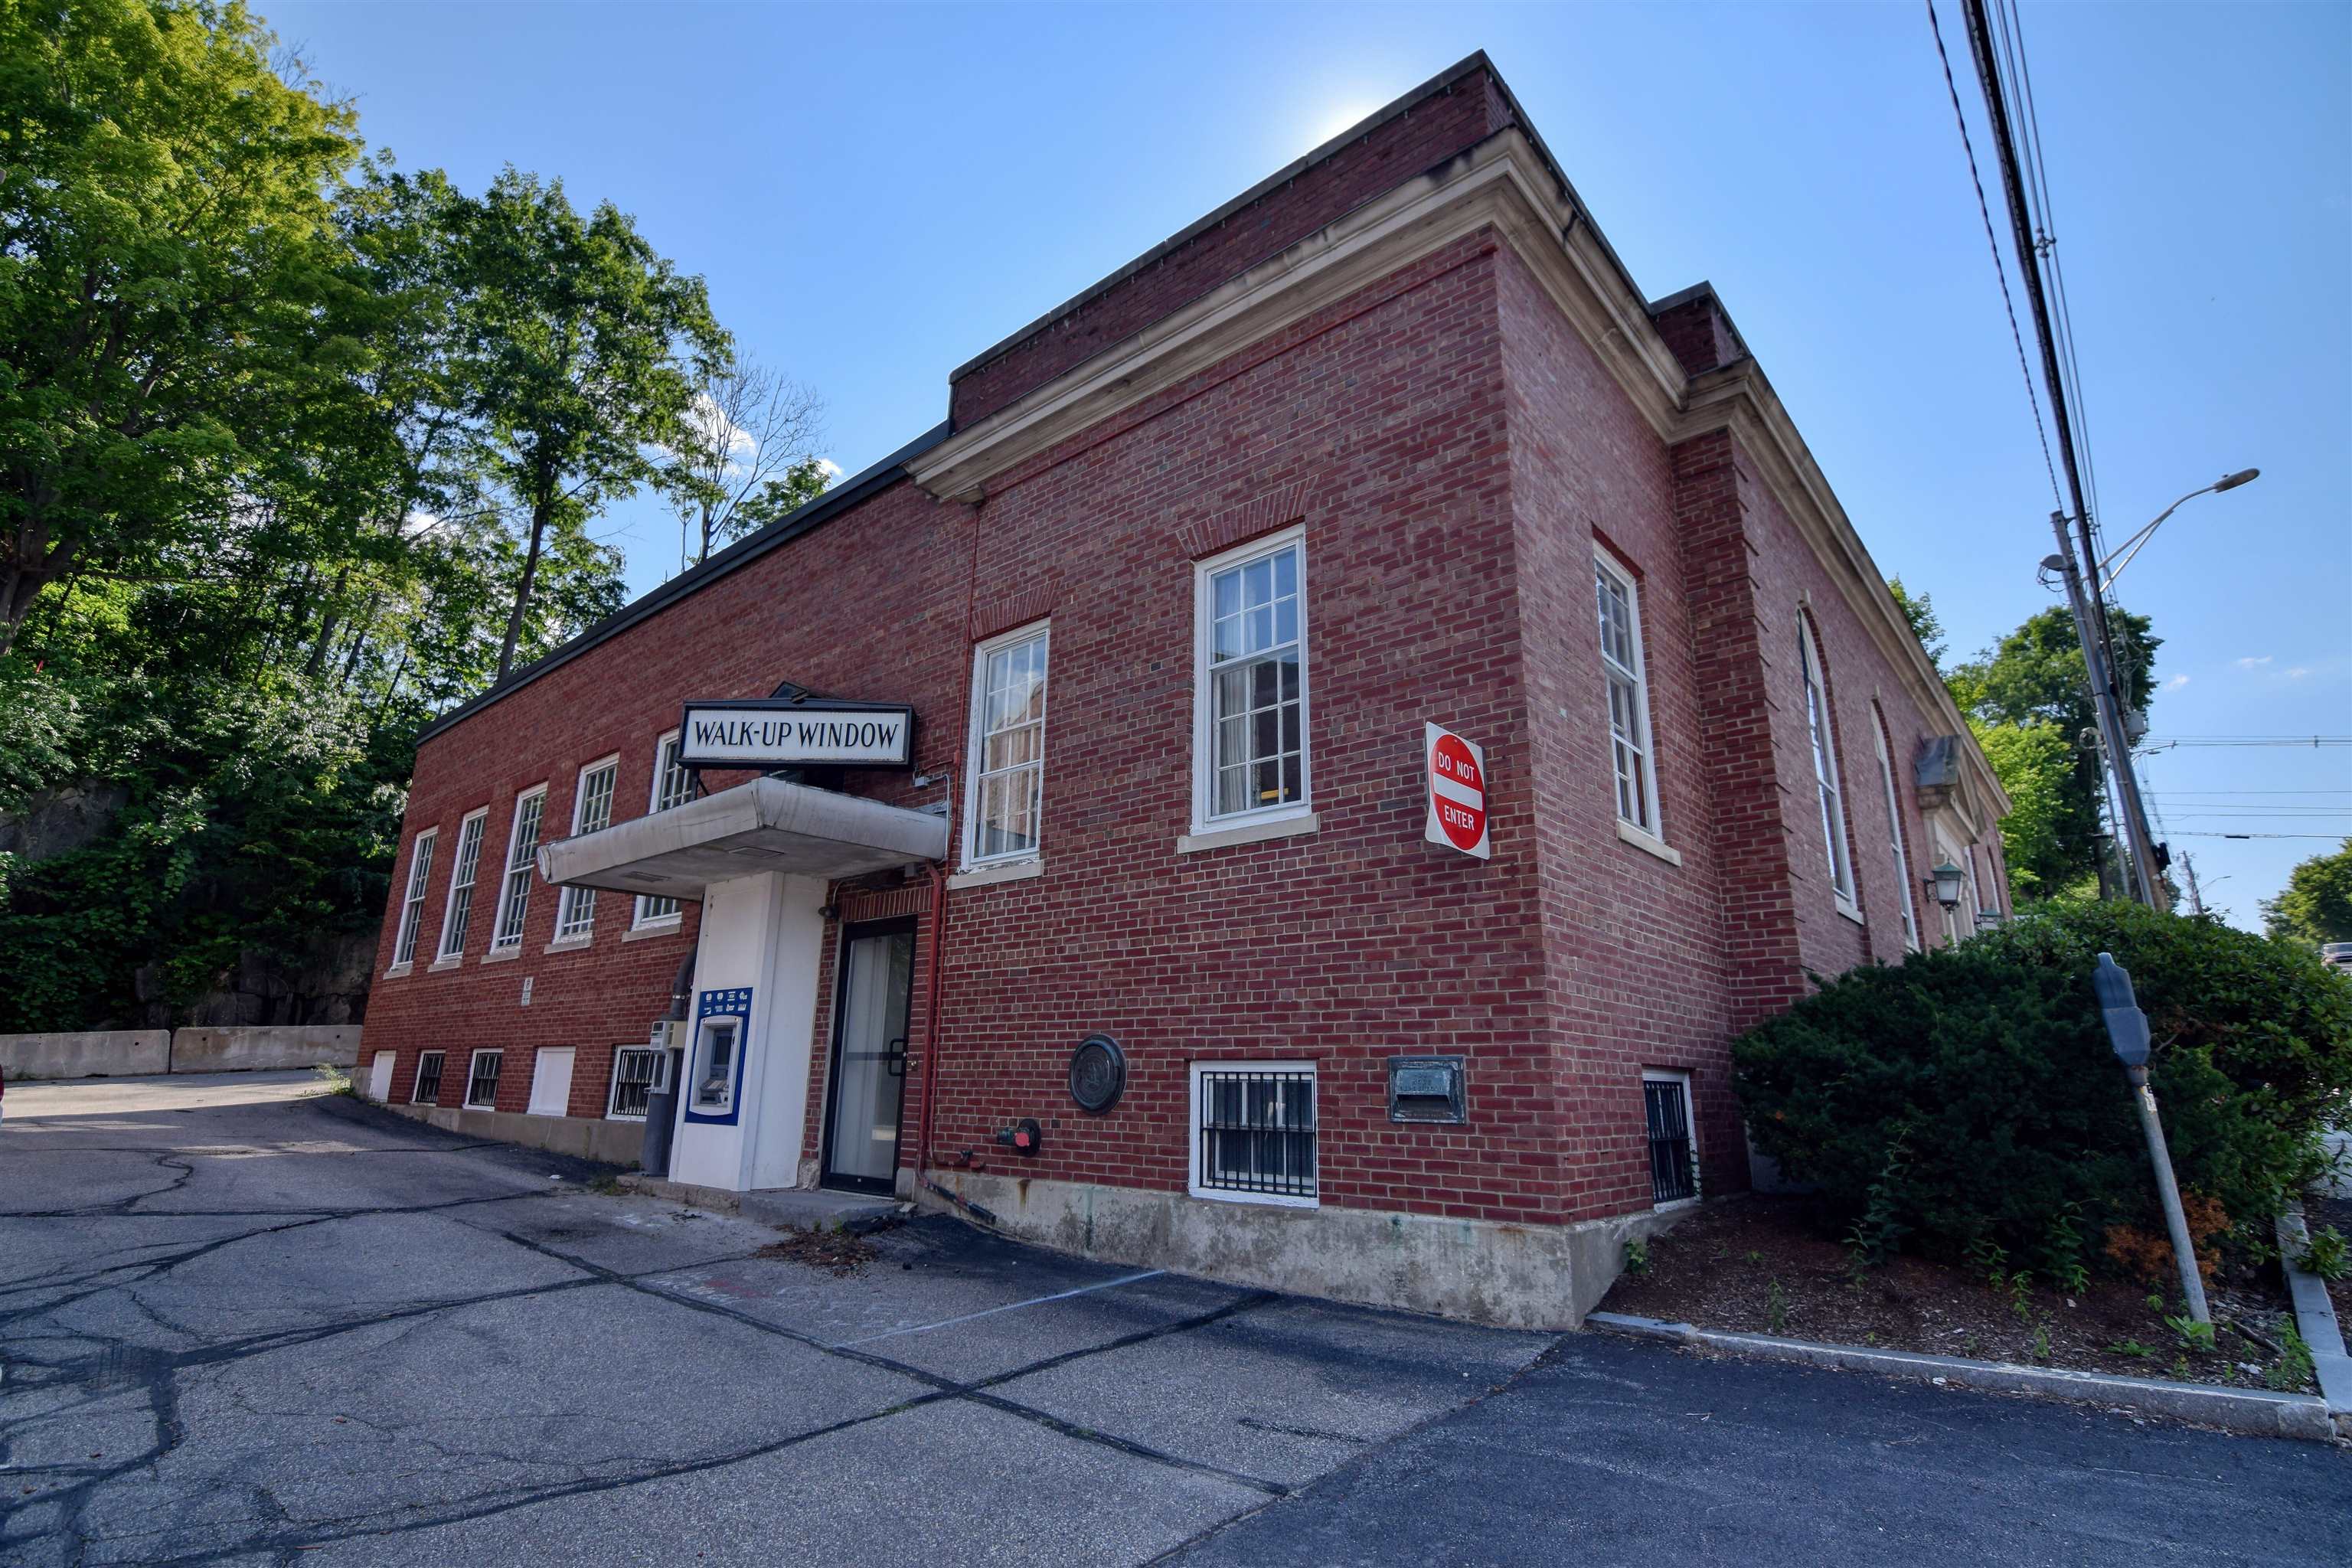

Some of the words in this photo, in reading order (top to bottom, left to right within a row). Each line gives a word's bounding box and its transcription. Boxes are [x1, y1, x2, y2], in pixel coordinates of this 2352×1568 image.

[695, 720, 792, 747] WALK-UP
[799, 722, 899, 748] WINDOW
[1438, 752, 1452, 771] DO
[1456, 760, 1475, 782] NOT
[1445, 805, 1475, 831] ENTER
